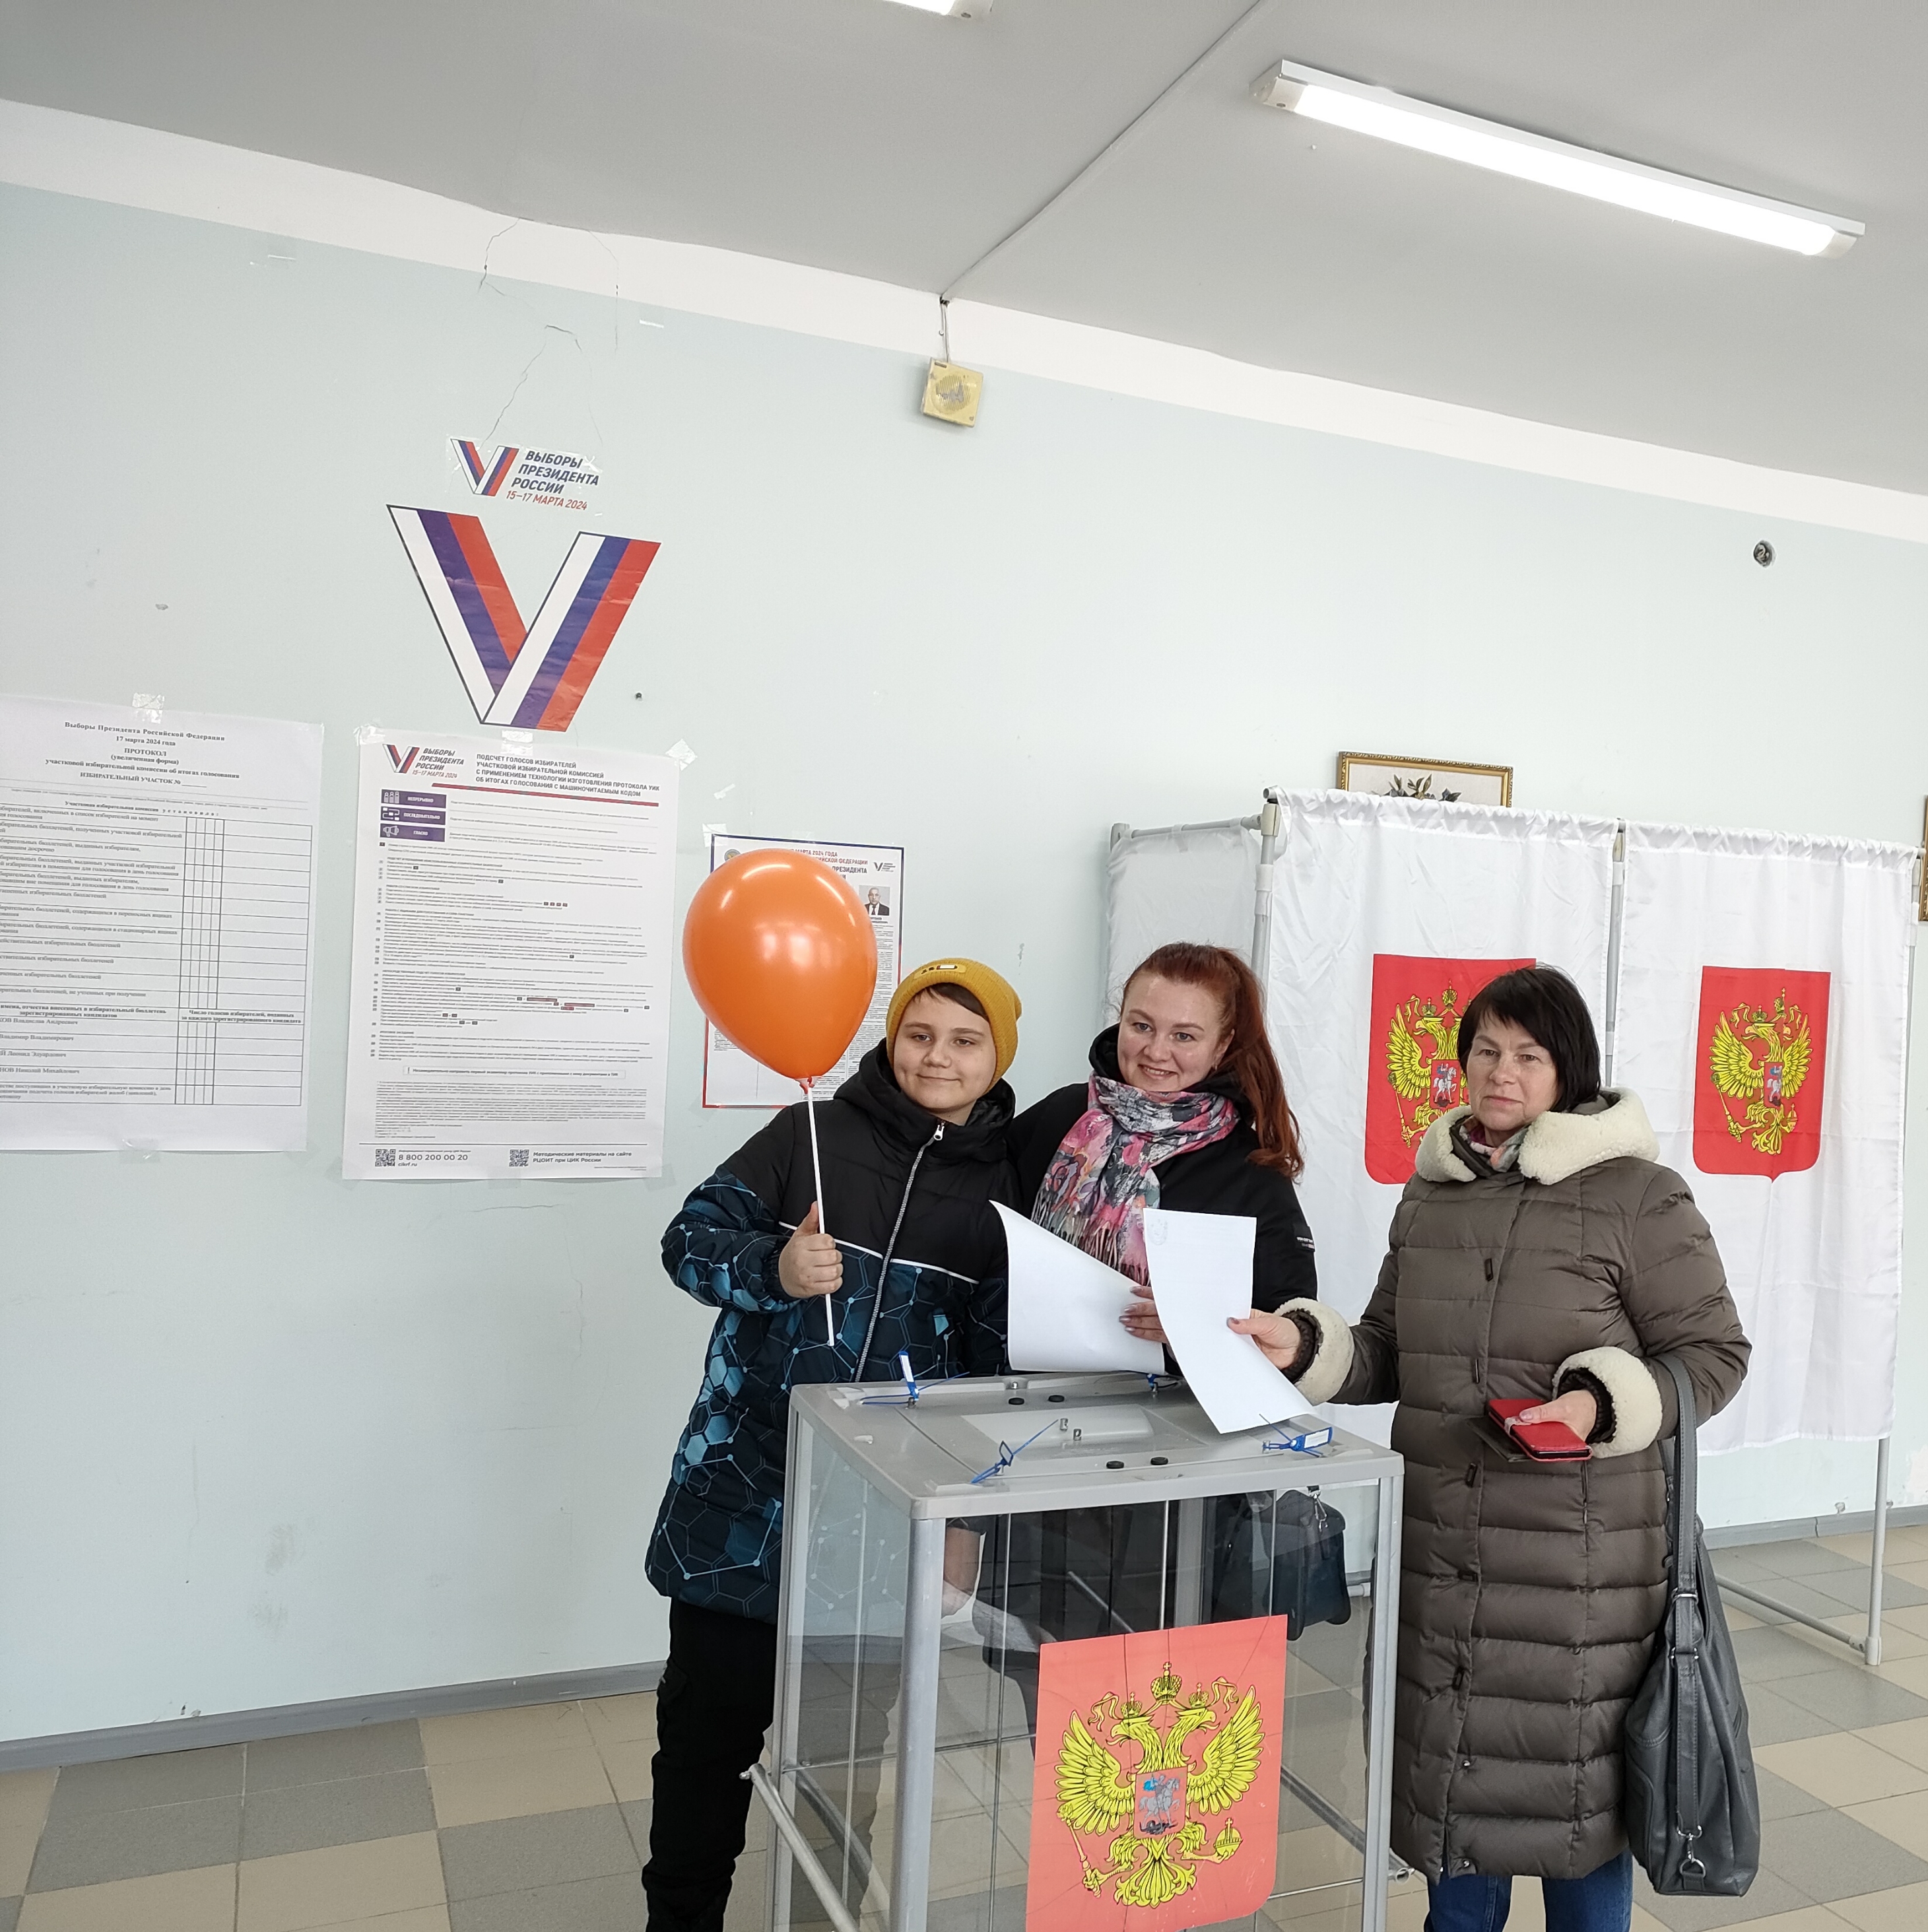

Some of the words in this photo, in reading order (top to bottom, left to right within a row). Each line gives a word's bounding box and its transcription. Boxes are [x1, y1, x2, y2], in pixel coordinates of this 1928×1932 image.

[525, 451, 583, 469] ВЫБОРЫ
[518, 464, 599, 486] ПРЕЗИДЕНТА
[511, 477, 564, 494] РОССИИ
[533, 494, 564, 507] МАРТА
[565, 499, 587, 510] 2024
[98, 725, 140, 733] Президента
[143, 729, 183, 737] Российской
[124, 748, 166, 756] ПРОТОКОЛ
[423, 748, 455, 756] ВЫБОРЫ
[419, 755, 464, 765] ПРЕЗИДЕНТА
[535, 760, 576, 768] ИЗБИРАТЕЛЕЙ
[86, 762, 135, 770] избирательной
[517, 766, 568, 775] ИЗБИРАТЕЛЬНОЙ
[81, 772, 139, 782] ИЗБИРАТЕЛЬНЫЙ
[482, 770, 527, 778] ПРИМЕНЕНИЕМ
[528, 774, 566, 782] ТЕХНОЛОГИИ
[568, 778, 612, 787] ИЗГОТОВЛЕНИЯ
[510, 780, 553, 788] ГОЛОСОВАНИЯ
[560, 784, 619, 795] МАШИНОЧИТАЕМЫМ
